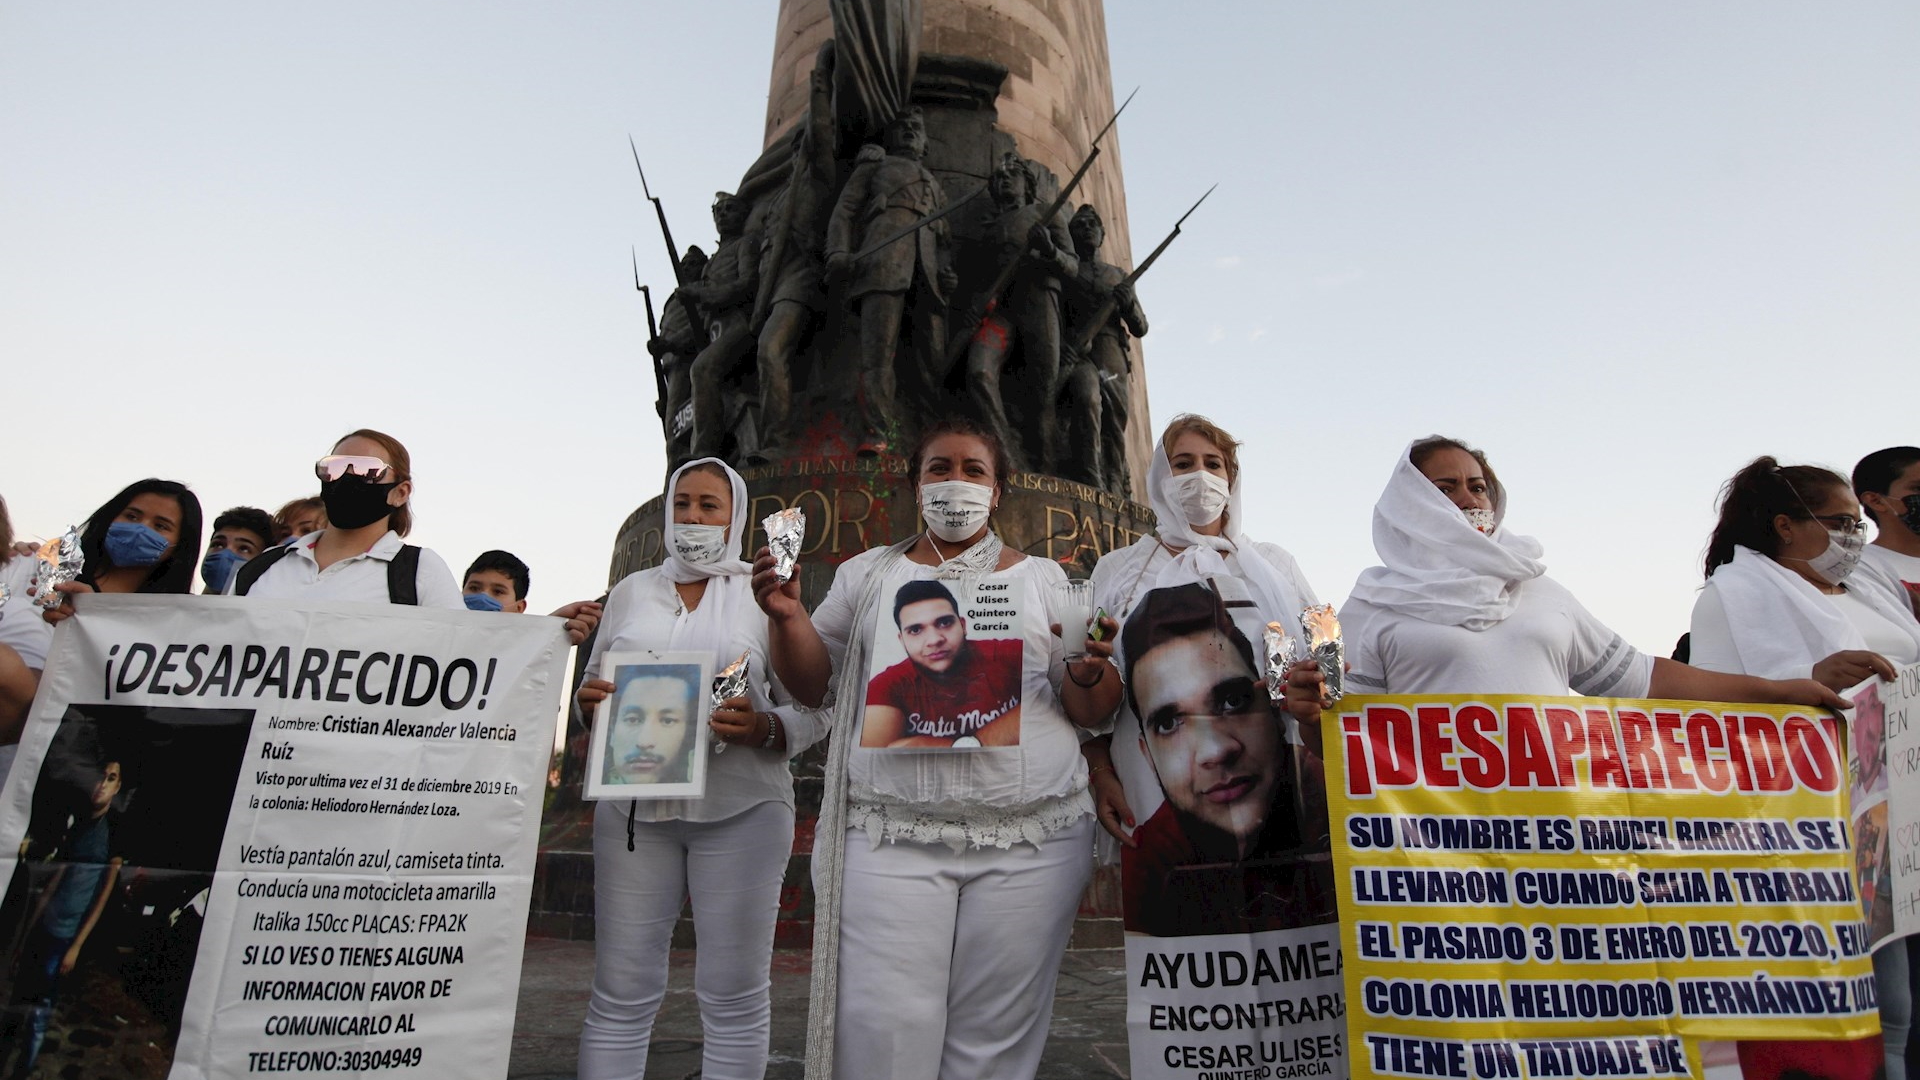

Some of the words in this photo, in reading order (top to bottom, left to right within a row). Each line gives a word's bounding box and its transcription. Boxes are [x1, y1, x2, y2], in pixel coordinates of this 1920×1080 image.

[978, 583, 1009, 591] Cesar
[976, 596, 1009, 604] Ulises
[967, 609, 1016, 619] Quintero
[973, 621, 1009, 631] García
[104, 641, 498, 711] ¡DESAPARECIDO!
[268, 716, 319, 732] Nombre:
[322, 715, 379, 736] Cristian
[382, 718, 456, 739] Alexander
[460, 721, 517, 741] Valencia
[908, 712, 957, 738] Santa
[1888, 707, 1908, 739] EN
[261, 741, 294, 760] Ruíz
[255, 771, 285, 786] Visto
[287, 775, 308, 790] por
[309, 773, 347, 789] ultima
[349, 778, 368, 790] vez
[370, 776, 382, 790] el
[383, 777, 398, 791] 31
[401, 777, 415, 792] de
[417, 778, 472, 794] diciembre
[474, 780, 501, 795] 2019
[504, 782, 518, 795] En
[249, 794, 259, 809] la
[262, 796, 309, 811] colonia:
[311, 798, 368, 814] Heliodoro
[369, 799, 429, 816] Hernández
[431, 802, 460, 817] Loza.
[1349, 816, 1394, 848] SU
[1400, 817, 1531, 850] NOMBRE
[1536, 818, 1575, 850] ES
[1579, 819, 1674, 850] RAUDEL
[1675, 820, 1799, 851] BARRERA
[1797, 820, 1839, 850] SE
[239, 844, 285, 866] Vestía
[287, 846, 354, 873] pantalón
[358, 848, 392, 872] azul,
[395, 850, 463, 870] camiseta
[466, 850, 505, 869] tinta.
[237, 877, 307, 899] Conducía
[311, 882, 339, 900] una
[343, 879, 433, 902] motocicleta
[436, 880, 496, 900] amarilla
[1354, 870, 1508, 903] LLEVARON
[1515, 871, 1635, 905] CUANDO
[1640, 871, 1711, 904] SALIA
[1712, 871, 1734, 903] A
[253, 911, 300, 932] Italika
[304, 912, 348, 933] 150cc
[351, 913, 415, 934] PLACAS:
[418, 913, 468, 933] FPA2K
[1359, 924, 1397, 958] EL
[1402, 926, 1527, 960] PASADO
[1532, 926, 1554, 960] 3
[1560, 927, 1601, 960] DE
[1605, 925, 1687, 961] ENERO
[1688, 924, 1742, 959] DEL
[1740, 924, 1837, 960] 2020,
[242, 944, 259, 966] SI
[261, 945, 284, 966] LO
[289, 945, 319, 966] VES
[321, 946, 334, 967] O
[339, 946, 393, 967] TIENES
[394, 945, 464, 967] ALGUNA
[243, 979, 364, 1002] INFORMACION
[370, 978, 425, 1002] FAVOR
[429, 978, 453, 999] DE
[1365, 980, 1506, 1019] COLONIA
[1510, 980, 1674, 1018] HELIODORO
[1678, 973, 1852, 1015] HERNÁNDEZ
[264, 1014, 392, 1036] COMUNICARLO
[394, 1013, 416, 1034] AL
[1150, 992, 1346, 1032] ENCONTRARL
[248, 1046, 422, 1073] TELEFONO:30304949
[1164, 1044, 1255, 1070] CESAR
[1260, 1033, 1342, 1064] ULISES
[1367, 1035, 1468, 1078] TIENE
[1471, 1042, 1520, 1079] UN
[1518, 1038, 1648, 1077] TATUAJE
[1647, 1037, 1688, 1074] DE
[1276, 1058, 1332, 1079] GARCÍA
